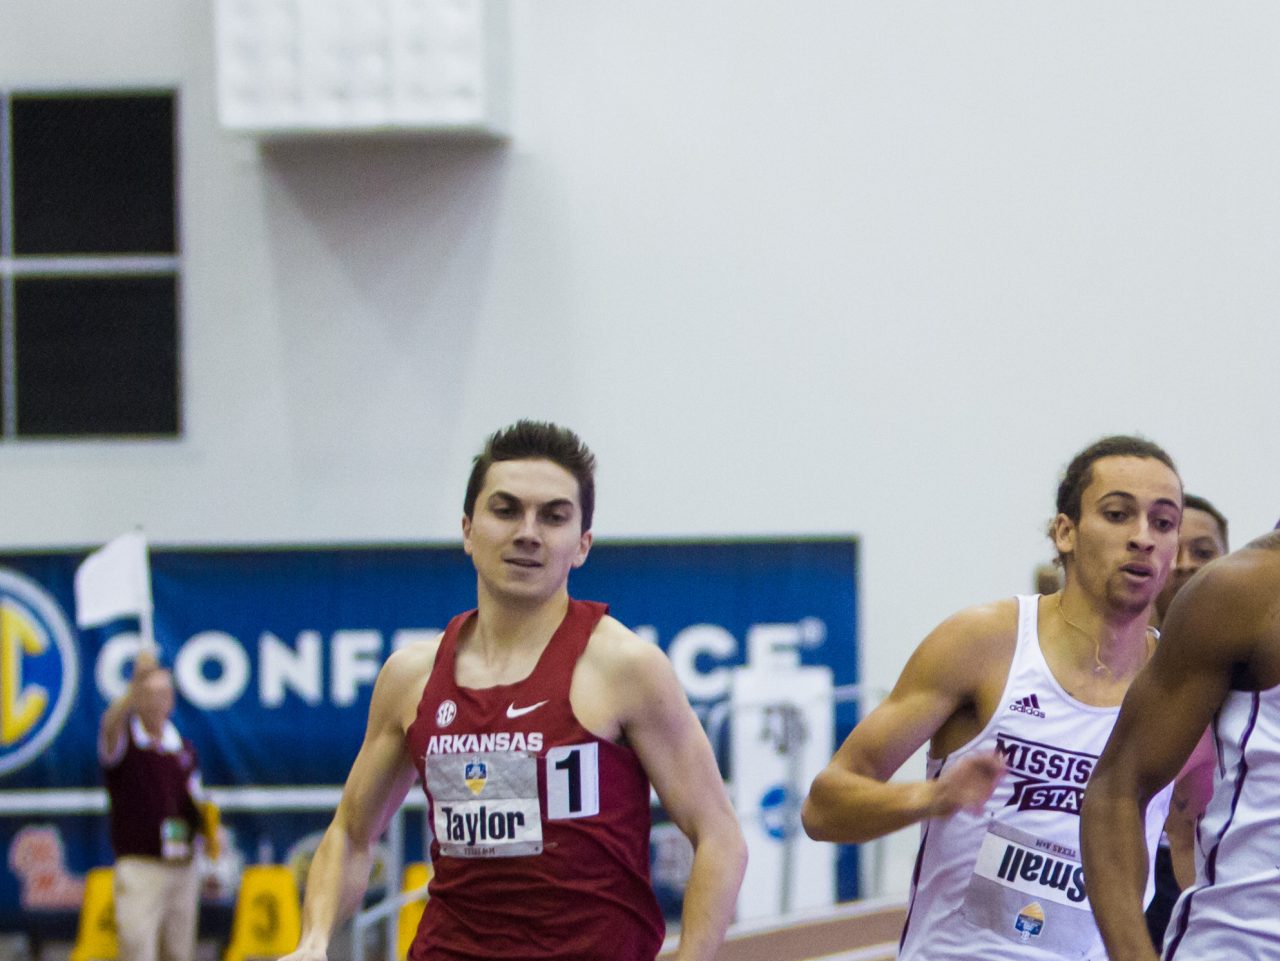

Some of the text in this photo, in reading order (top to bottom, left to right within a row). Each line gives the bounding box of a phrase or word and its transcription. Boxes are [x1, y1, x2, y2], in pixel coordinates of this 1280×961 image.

[436, 700, 457, 727] SEC
[1010, 704, 1045, 719] adidas
[427, 733, 544, 754] ARKANSAS
[995, 738, 1093, 784] MISSIS
[556, 750, 582, 812] 1
[1030, 790, 1084, 810] STA
[442, 806, 525, 846] Taylor
[997, 845, 1087, 903] Small
